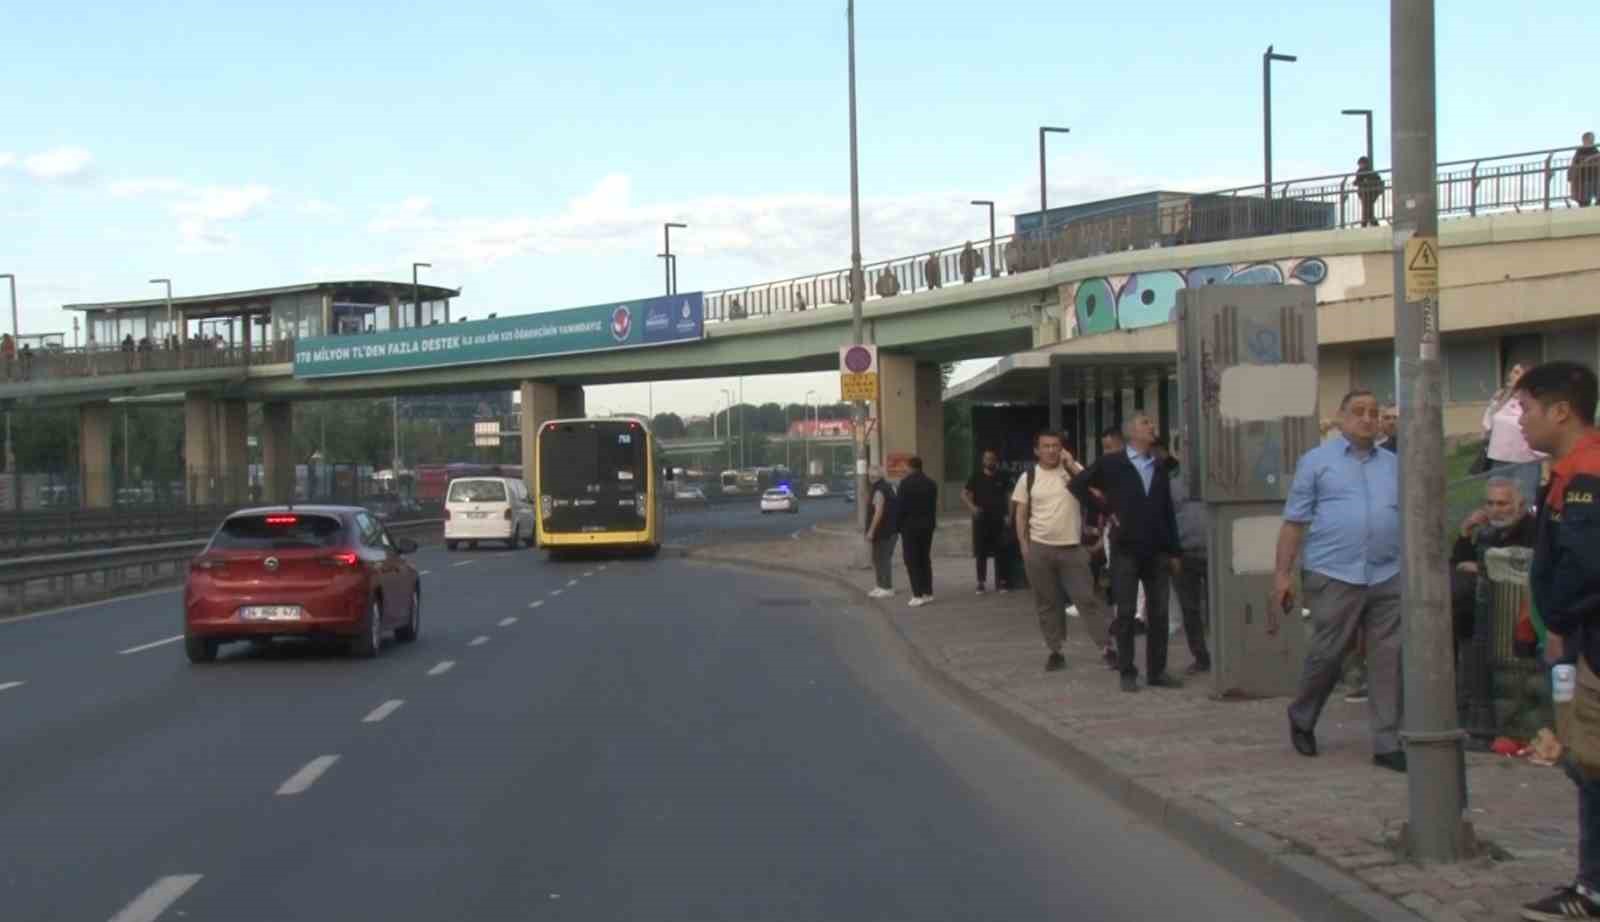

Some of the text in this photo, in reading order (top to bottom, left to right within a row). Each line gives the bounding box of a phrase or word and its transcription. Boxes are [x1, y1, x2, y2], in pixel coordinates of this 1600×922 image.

[313, 346, 350, 362] MİLYON
[353, 343, 385, 358] TL'DEN
[388, 341, 421, 355] FAZLA
[422, 335, 461, 352] DESTEK
